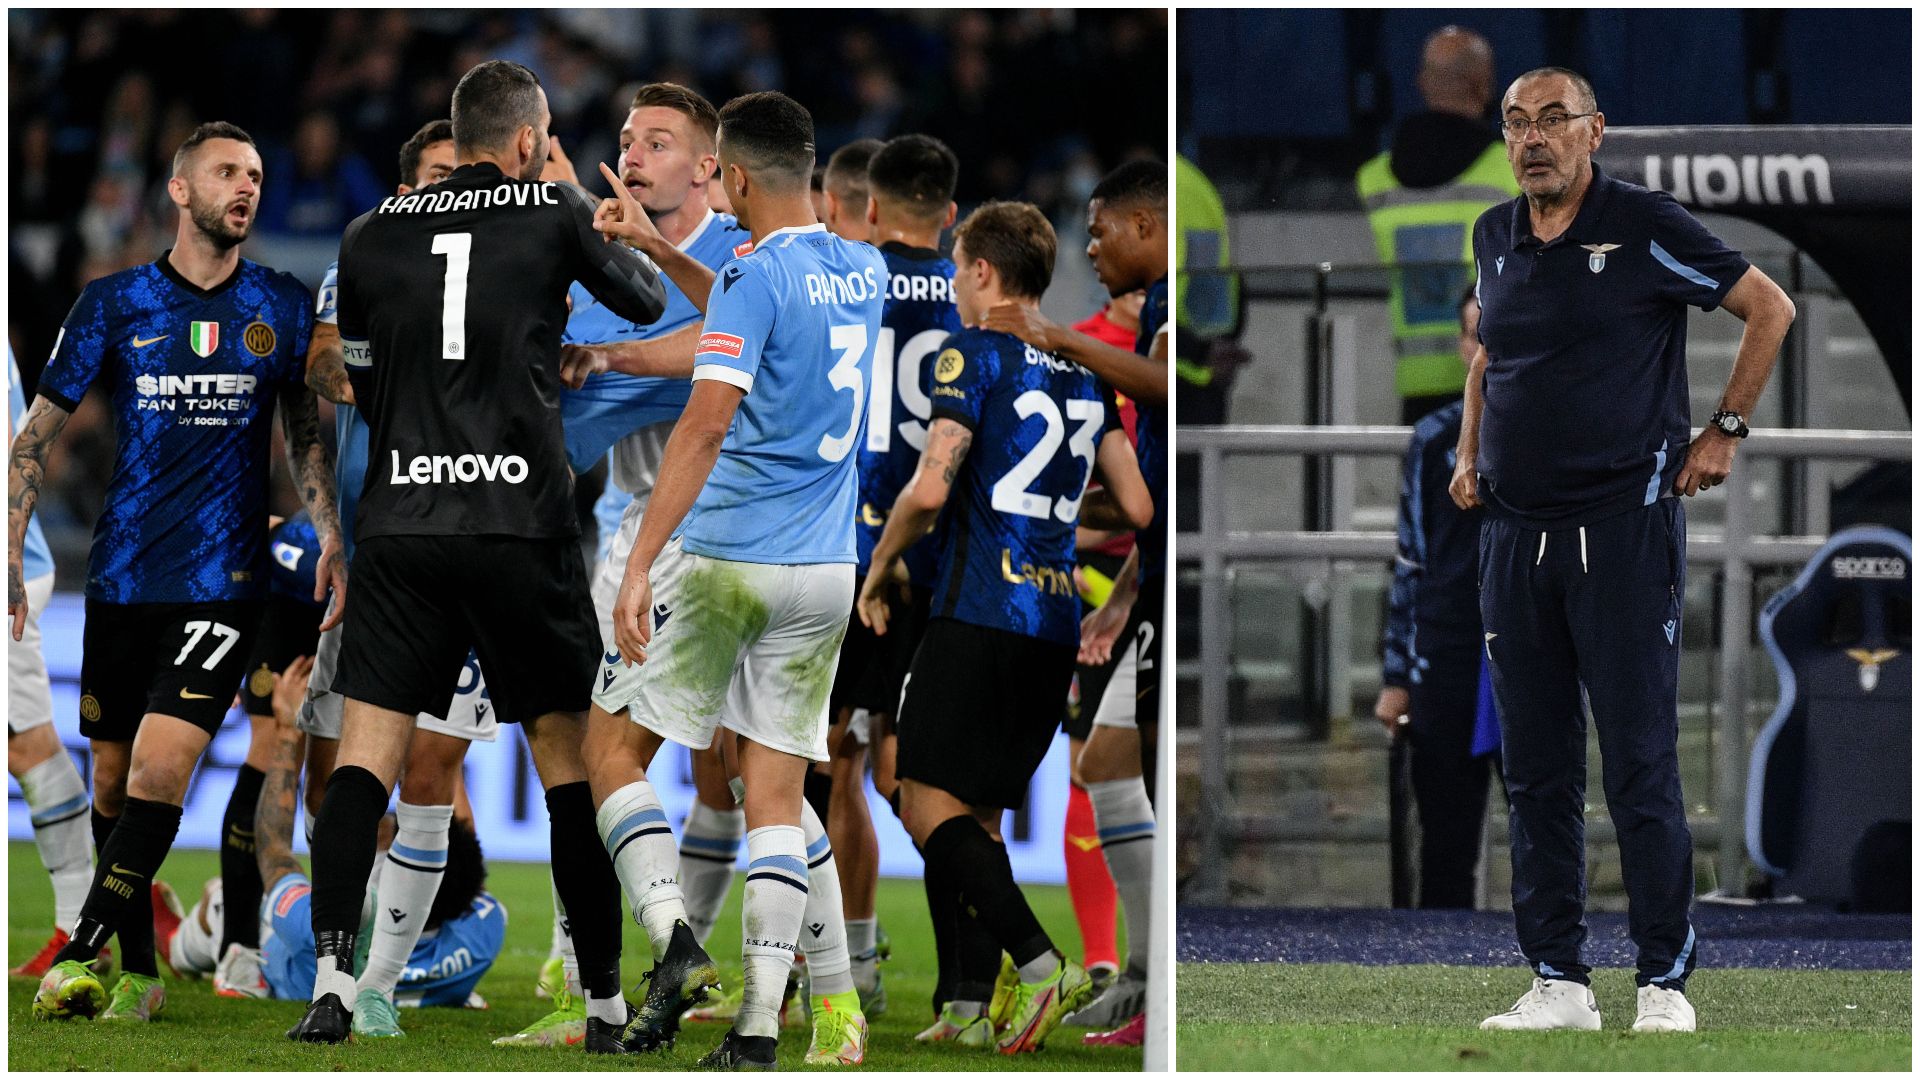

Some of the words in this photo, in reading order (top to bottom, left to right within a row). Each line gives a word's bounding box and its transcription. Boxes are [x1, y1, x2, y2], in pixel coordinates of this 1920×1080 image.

[1645, 153, 1835, 205] upim
[431, 233, 472, 360] 1
[805, 266, 878, 306] RAMOS
[135, 373, 258, 398] $INTER
[137, 399, 176, 411] FAN
[185, 398, 251, 411] TOKEN
[817, 324, 868, 462] 3
[390, 449, 529, 485] Lenovo
[991, 390, 1105, 524] 23
[174, 620, 240, 671] 77
[102, 874, 134, 899] INTER
